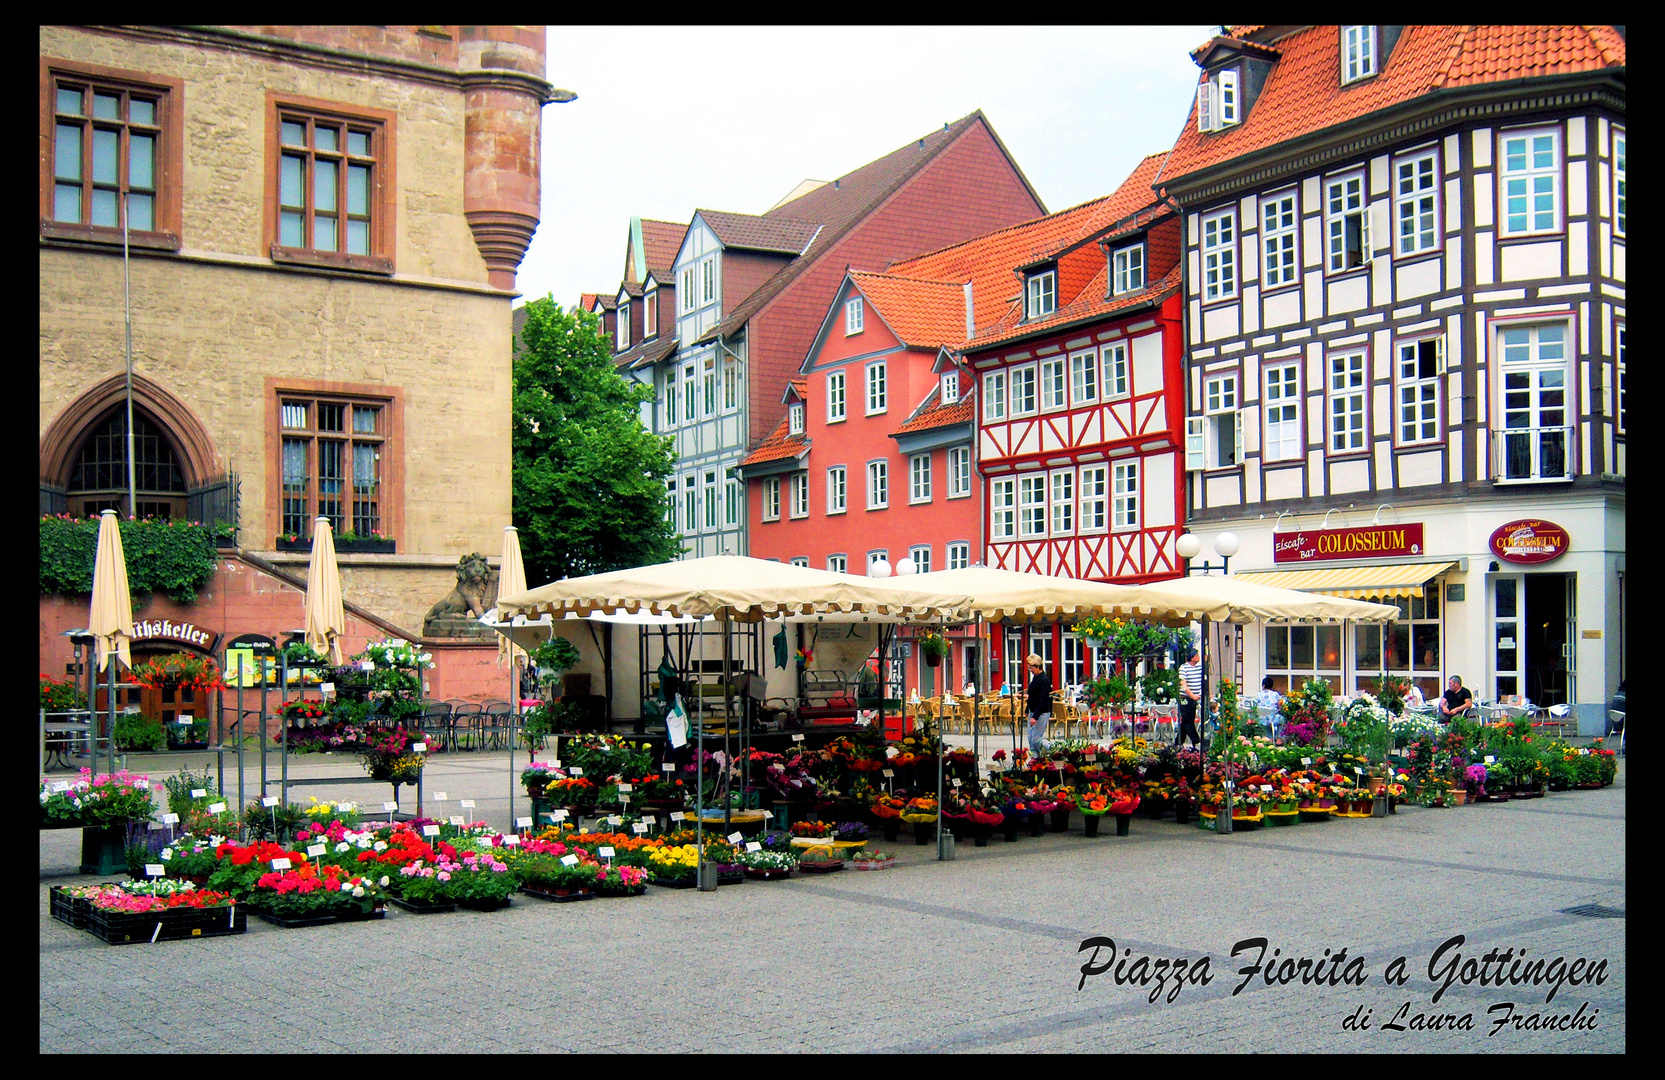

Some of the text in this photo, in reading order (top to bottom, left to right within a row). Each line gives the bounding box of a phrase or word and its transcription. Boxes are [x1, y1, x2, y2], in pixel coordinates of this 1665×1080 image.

[1318, 529, 1406, 553] COLOSSEUM
[1496, 536, 1561, 549] COLOSSEUM
[132, 619, 209, 645] thskeller
